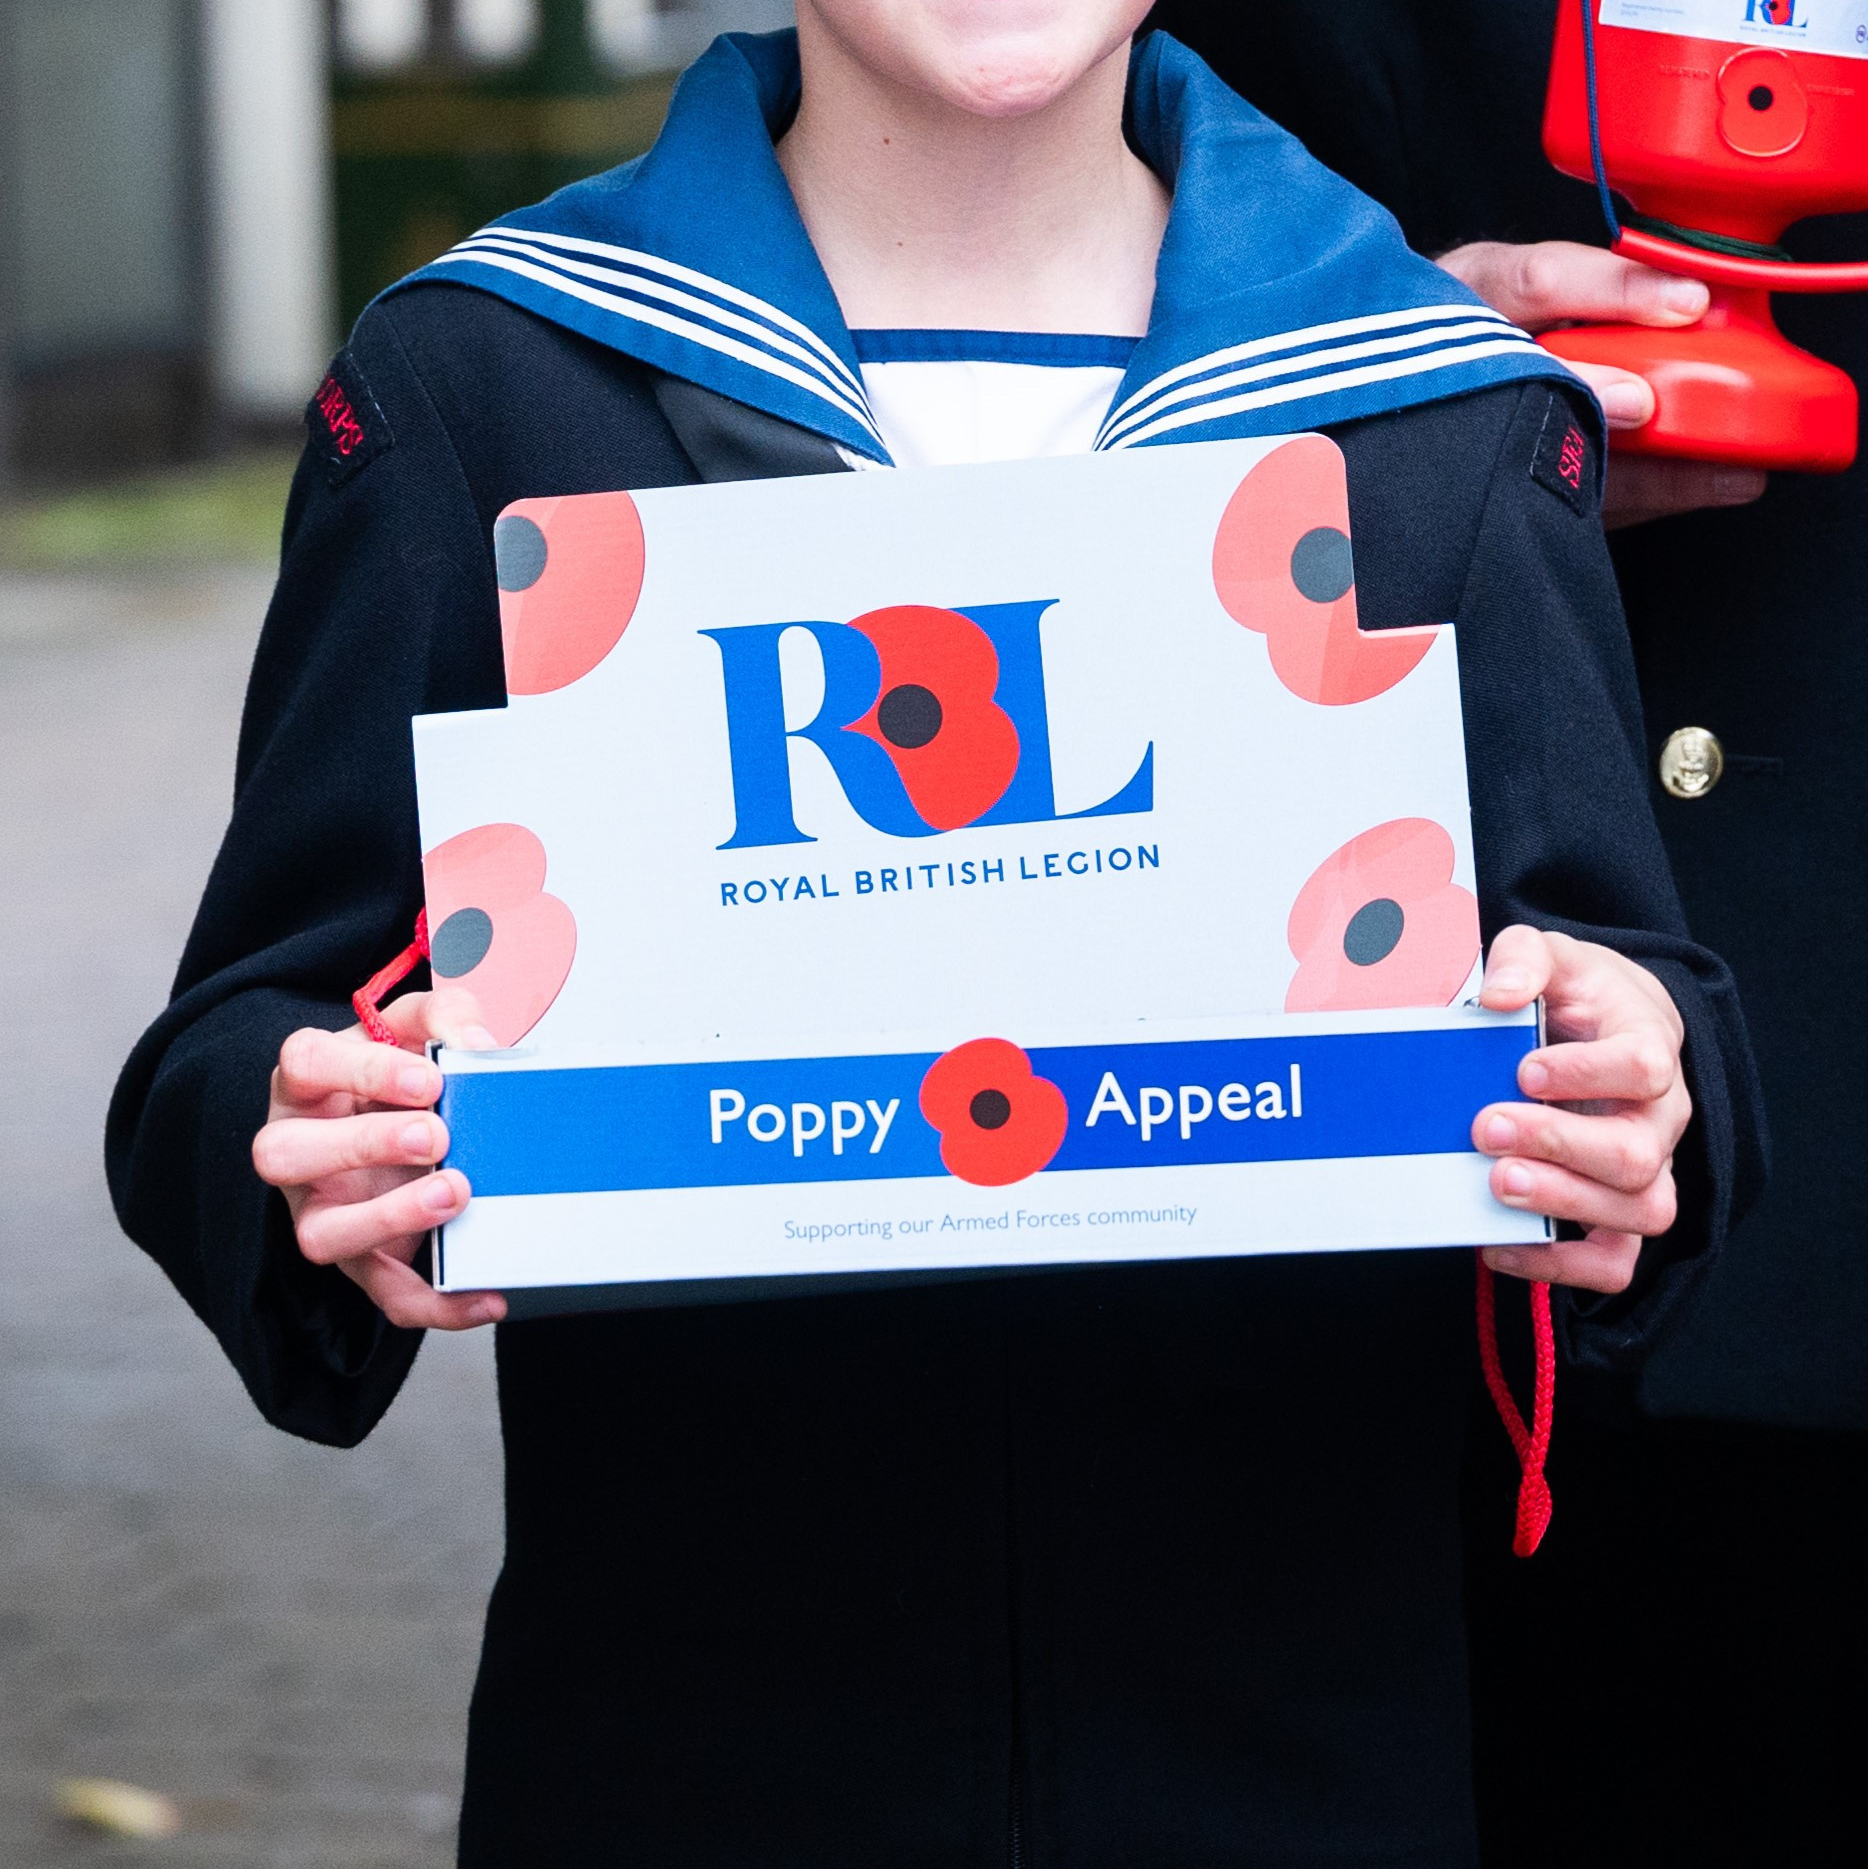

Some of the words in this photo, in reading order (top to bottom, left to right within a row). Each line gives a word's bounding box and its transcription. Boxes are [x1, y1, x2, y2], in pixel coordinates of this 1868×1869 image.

[720, 873, 840, 907] ROYAL
[855, 858, 1005, 895] BRITISH
[1019, 844, 1160, 880] LEGION
[710, 1088, 901, 1157] Poppy
[1084, 1063, 1303, 1142] Appeal
[784, 1218, 893, 1244] Supporting
[898, 1218, 934, 1235] our
[940, 1212, 1010, 1233] Armed
[1016, 1208, 1082, 1229] Forces
[1087, 1203, 1198, 1229] community
